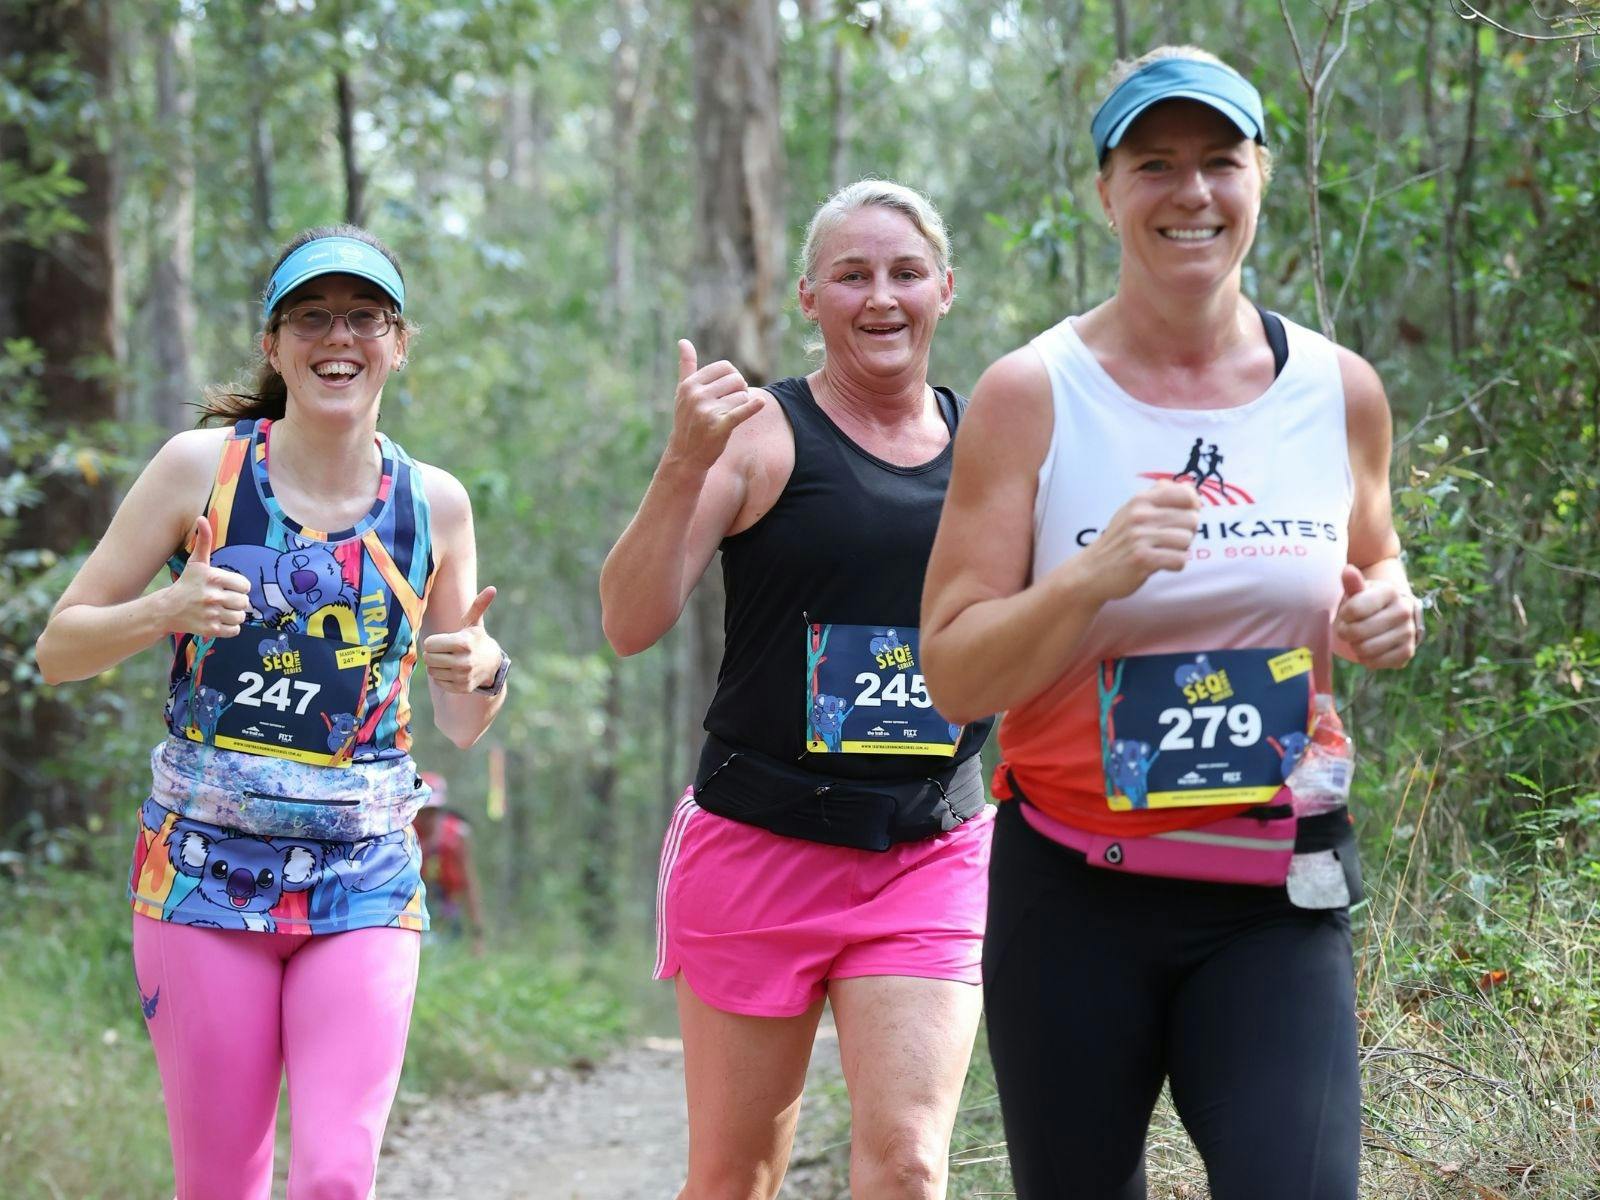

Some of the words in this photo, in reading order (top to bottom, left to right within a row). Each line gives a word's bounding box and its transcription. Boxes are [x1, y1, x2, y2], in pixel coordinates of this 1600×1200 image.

[1220, 519, 1337, 542] KATE'S
[1224, 545, 1307, 559] SQUAD
[262, 651, 294, 672] SEQ
[343, 657, 354, 665] 247
[876, 647, 907, 669] SEQ
[897, 660, 914, 670] SERIES
[283, 667, 302, 675] SERIES
[233, 671, 322, 715] 247
[854, 672, 934, 709] 245
[1183, 673, 1221, 704] SEQ
[903, 729, 918, 737] FIXX
[1158, 703, 1262, 751] 279
